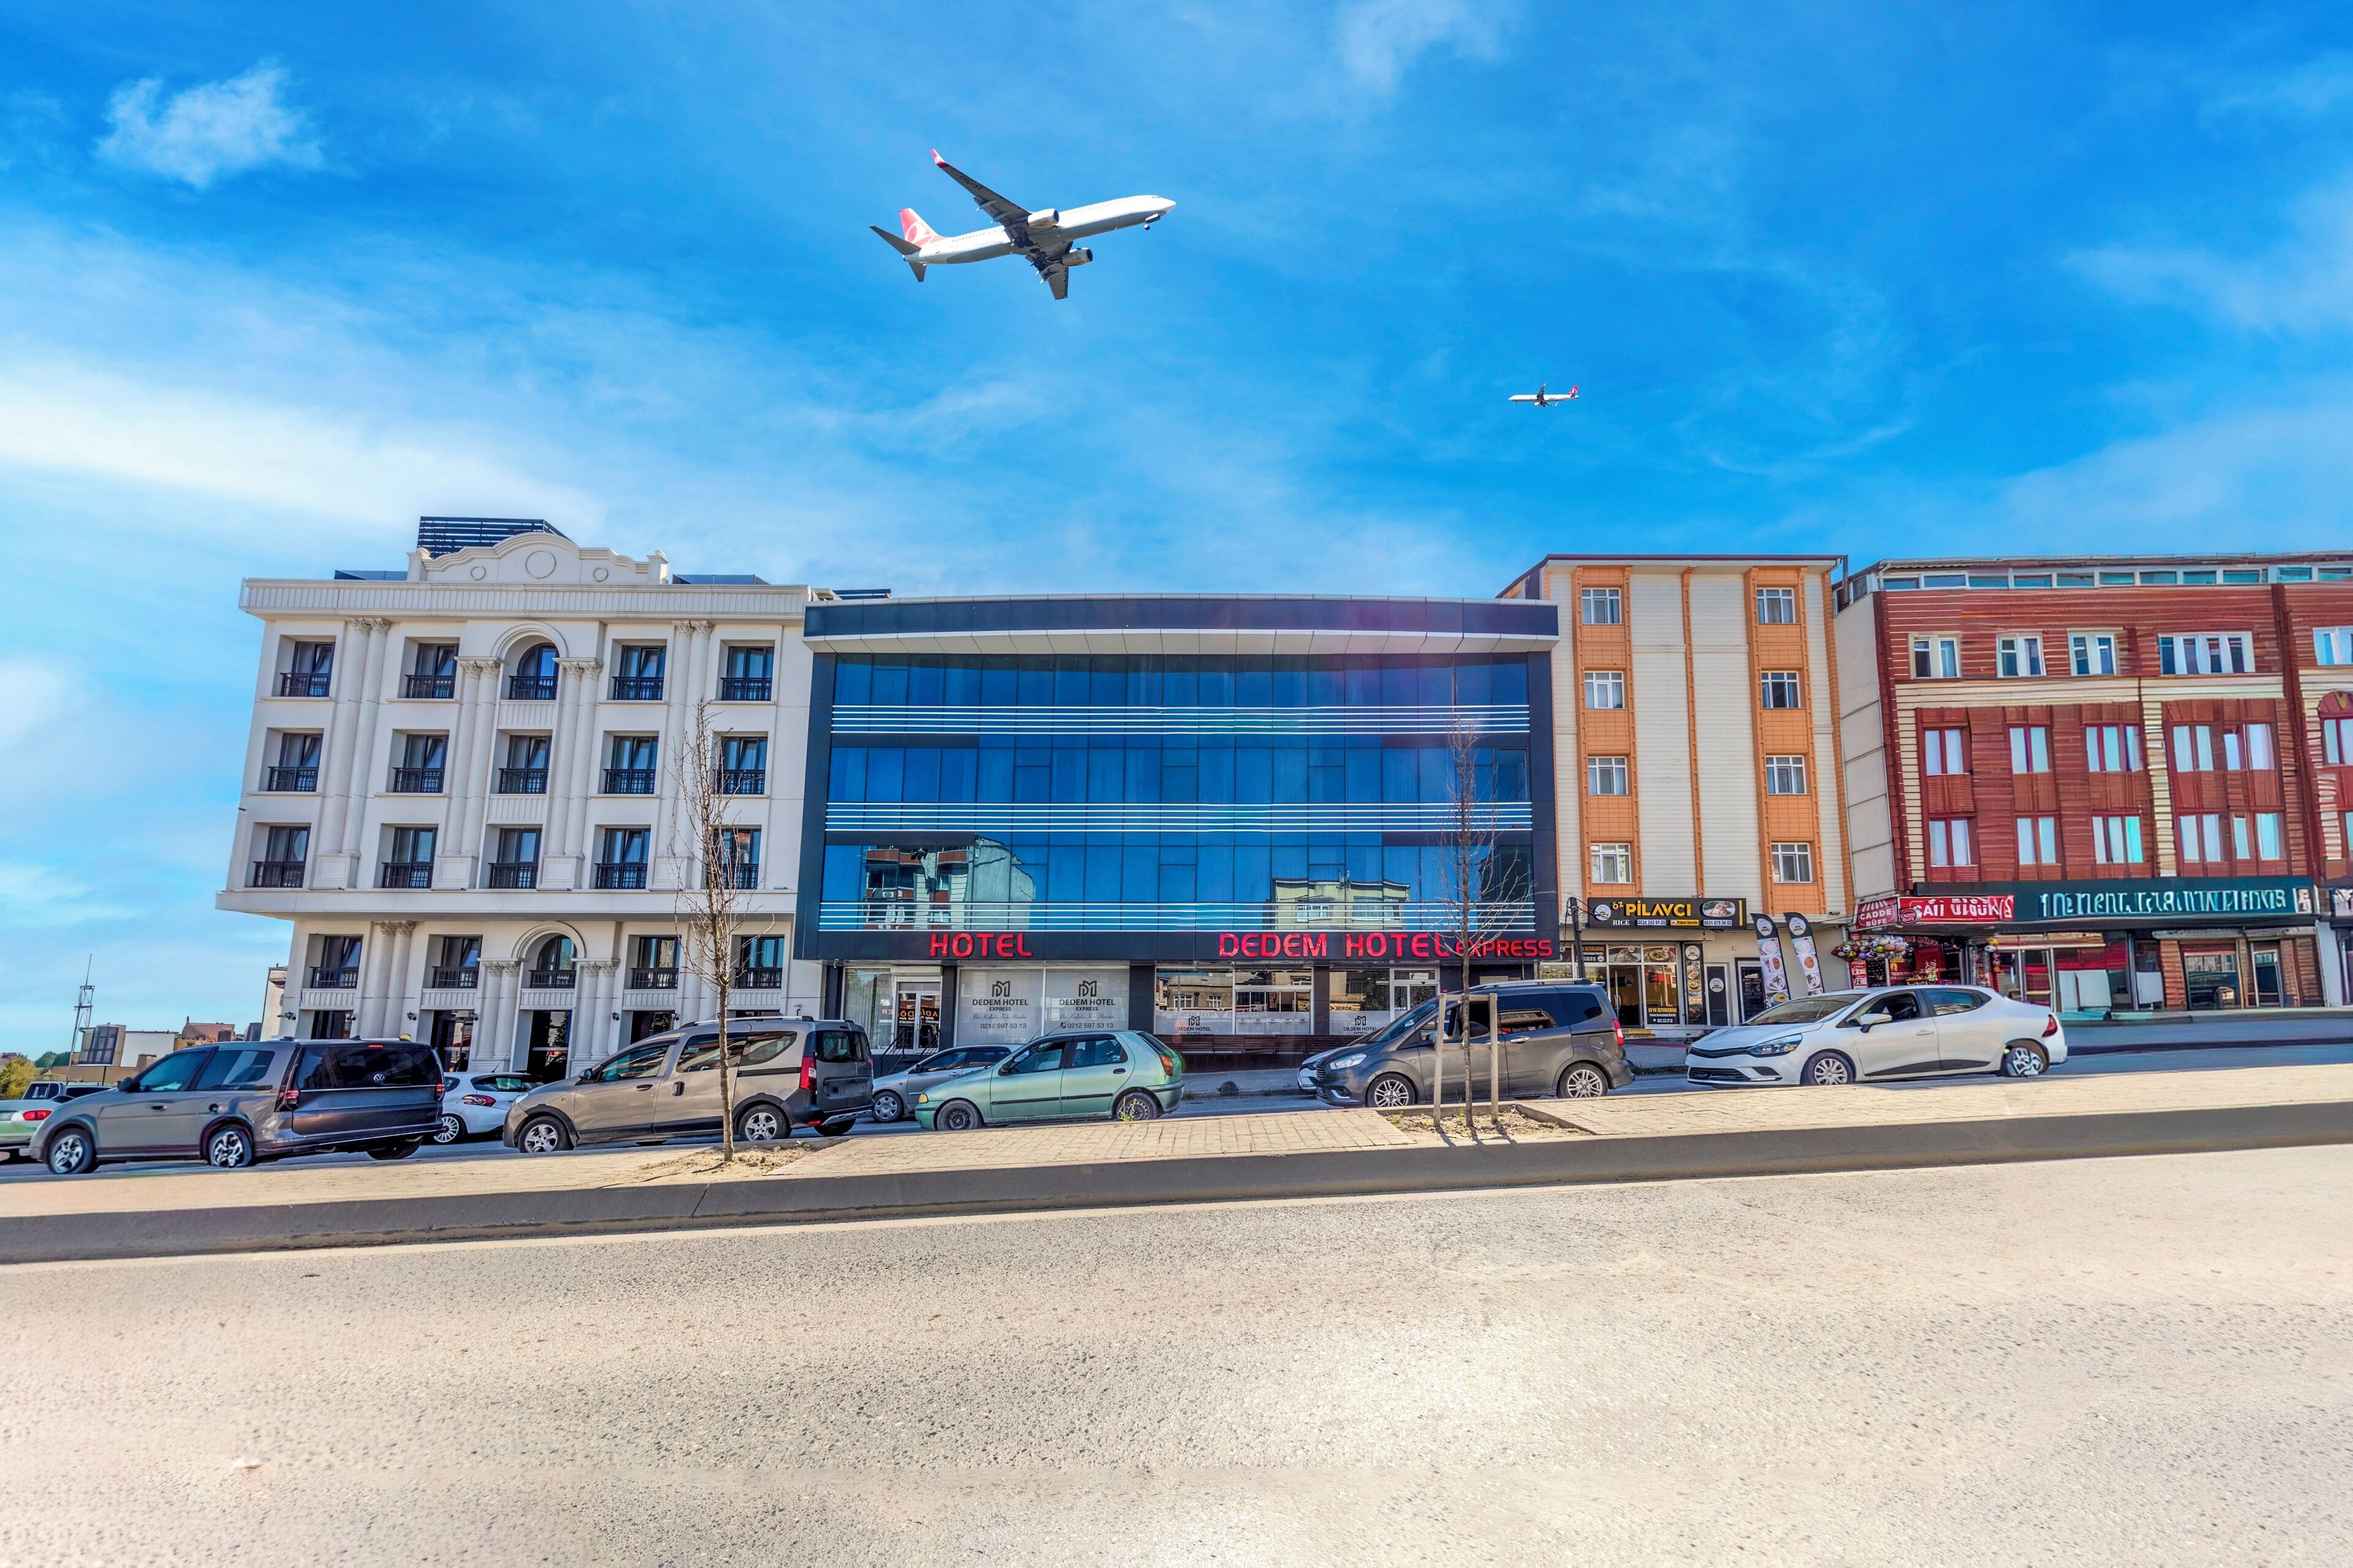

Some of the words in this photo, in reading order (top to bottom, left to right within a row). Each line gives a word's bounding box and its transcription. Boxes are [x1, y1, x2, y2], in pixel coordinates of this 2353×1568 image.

[1626, 900, 1691, 917] PİLAVCI
[1860, 909, 1892, 920] CADDE
[1866, 918, 1887, 927] BÜFE
[930, 933, 1033, 958] HOTEL
[1219, 933, 1327, 958] DEDEM
[1346, 933, 1450, 958] HOTEL
[1455, 939, 1553, 957] EXPRESS
